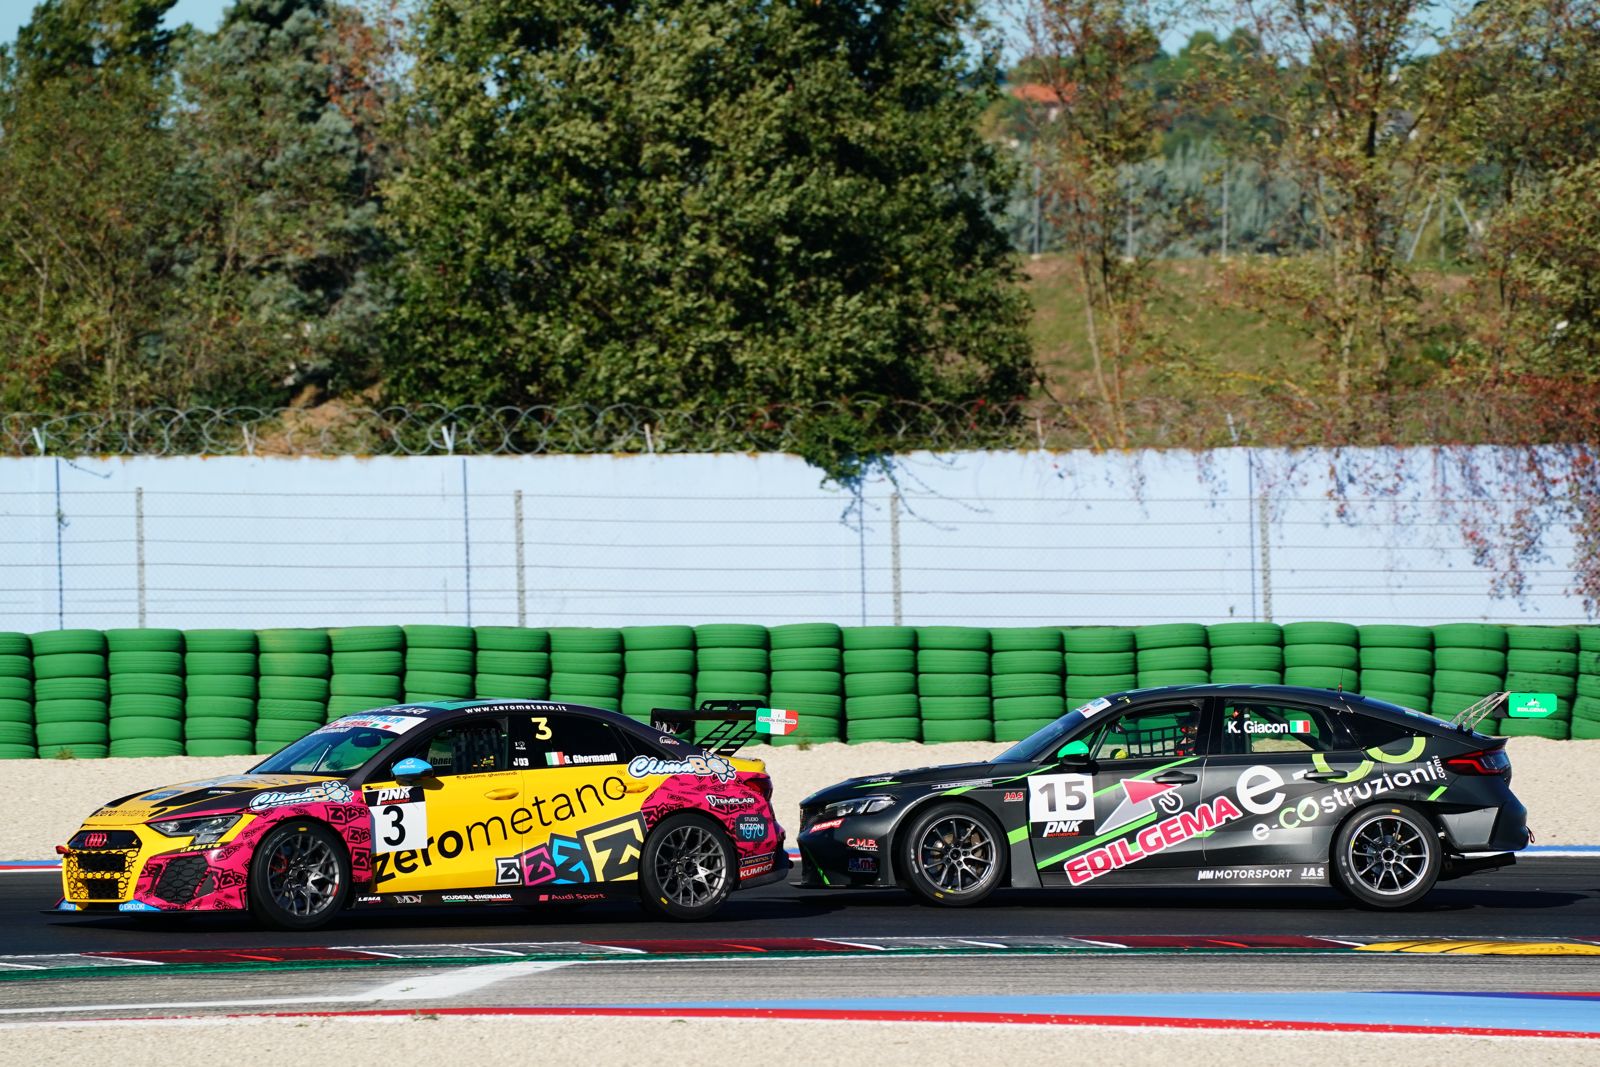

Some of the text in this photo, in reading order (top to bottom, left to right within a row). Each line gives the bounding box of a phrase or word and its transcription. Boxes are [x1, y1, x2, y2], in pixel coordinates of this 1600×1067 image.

[465, 704, 568, 714] www.zerometano.it
[531, 717, 552, 740] 3
[1227, 721, 1289, 734] K. Giacon
[573, 753, 618, 764] Ghermandi
[1037, 780, 1088, 813] 15
[382, 805, 406, 847] 3
[1064, 795, 1243, 887] EDILGEMA
[740, 863, 773, 878] KUMHO
[1215, 869, 1293, 879] MOTORSPORT
[1300, 867, 1325, 877] JAS
[575, 892, 608, 900] Sport
